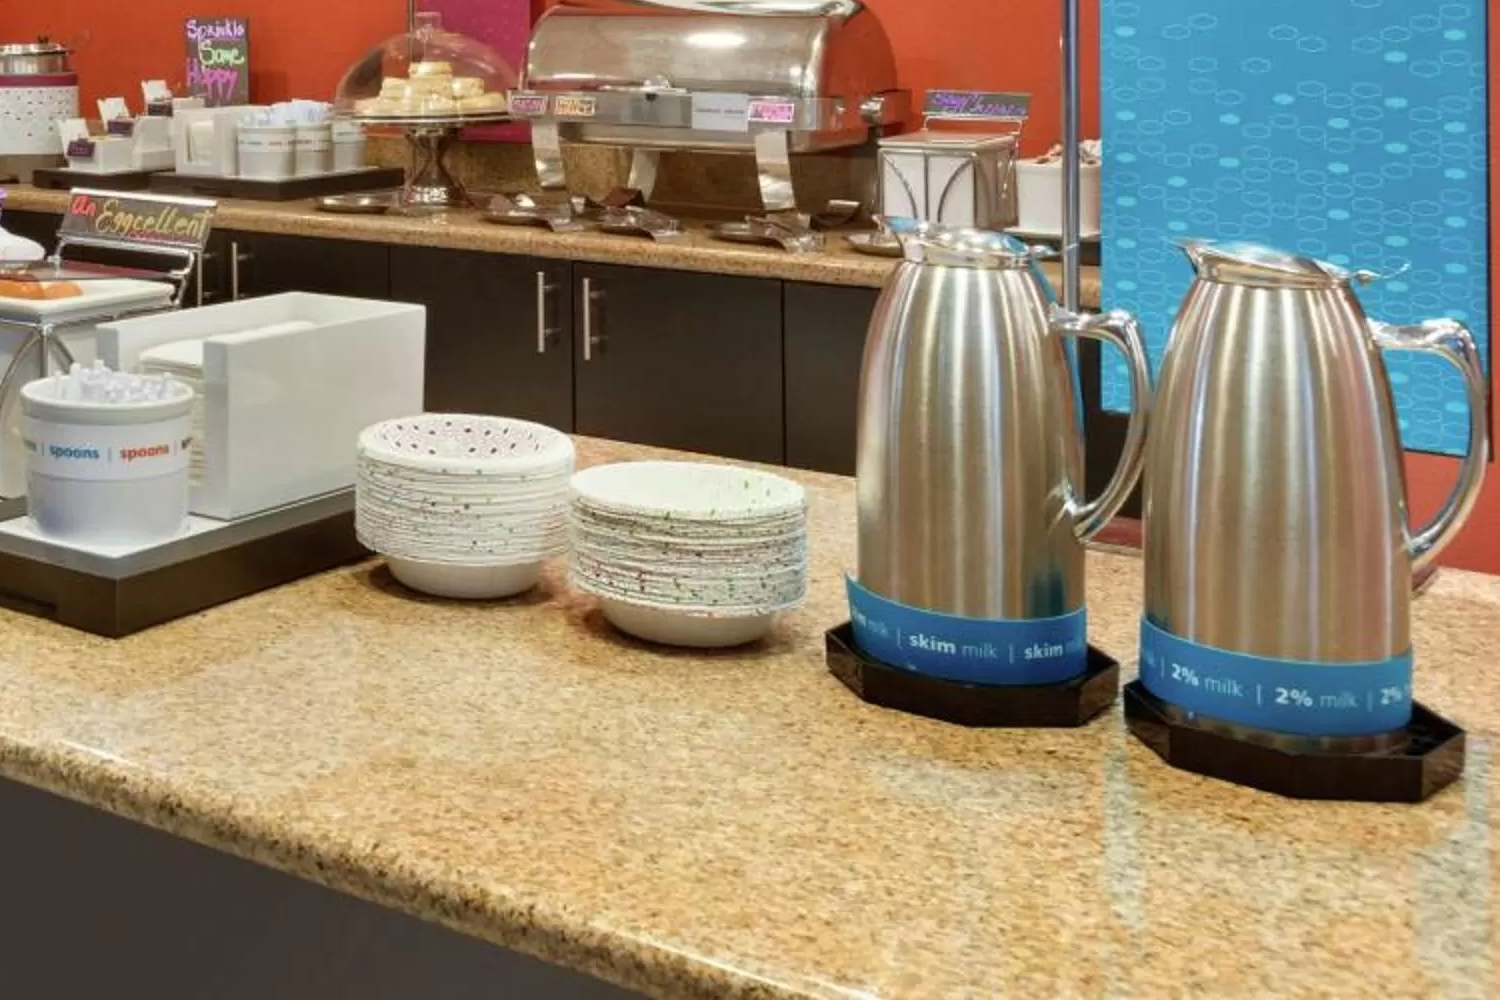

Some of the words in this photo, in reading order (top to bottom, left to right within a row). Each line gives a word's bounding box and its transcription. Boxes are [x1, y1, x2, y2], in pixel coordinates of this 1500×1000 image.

[49, 444, 100, 463] spoons
[120, 444, 170, 463] spoons
[909, 633, 956, 656] skim
[962, 644, 998, 660] milk
[1024, 643, 1063, 661] skim
[1171, 662, 1199, 687] 2%
[1204, 675, 1244, 698] milk
[1275, 687, 1313, 708] 2%
[1319, 692, 1358, 709] milk
